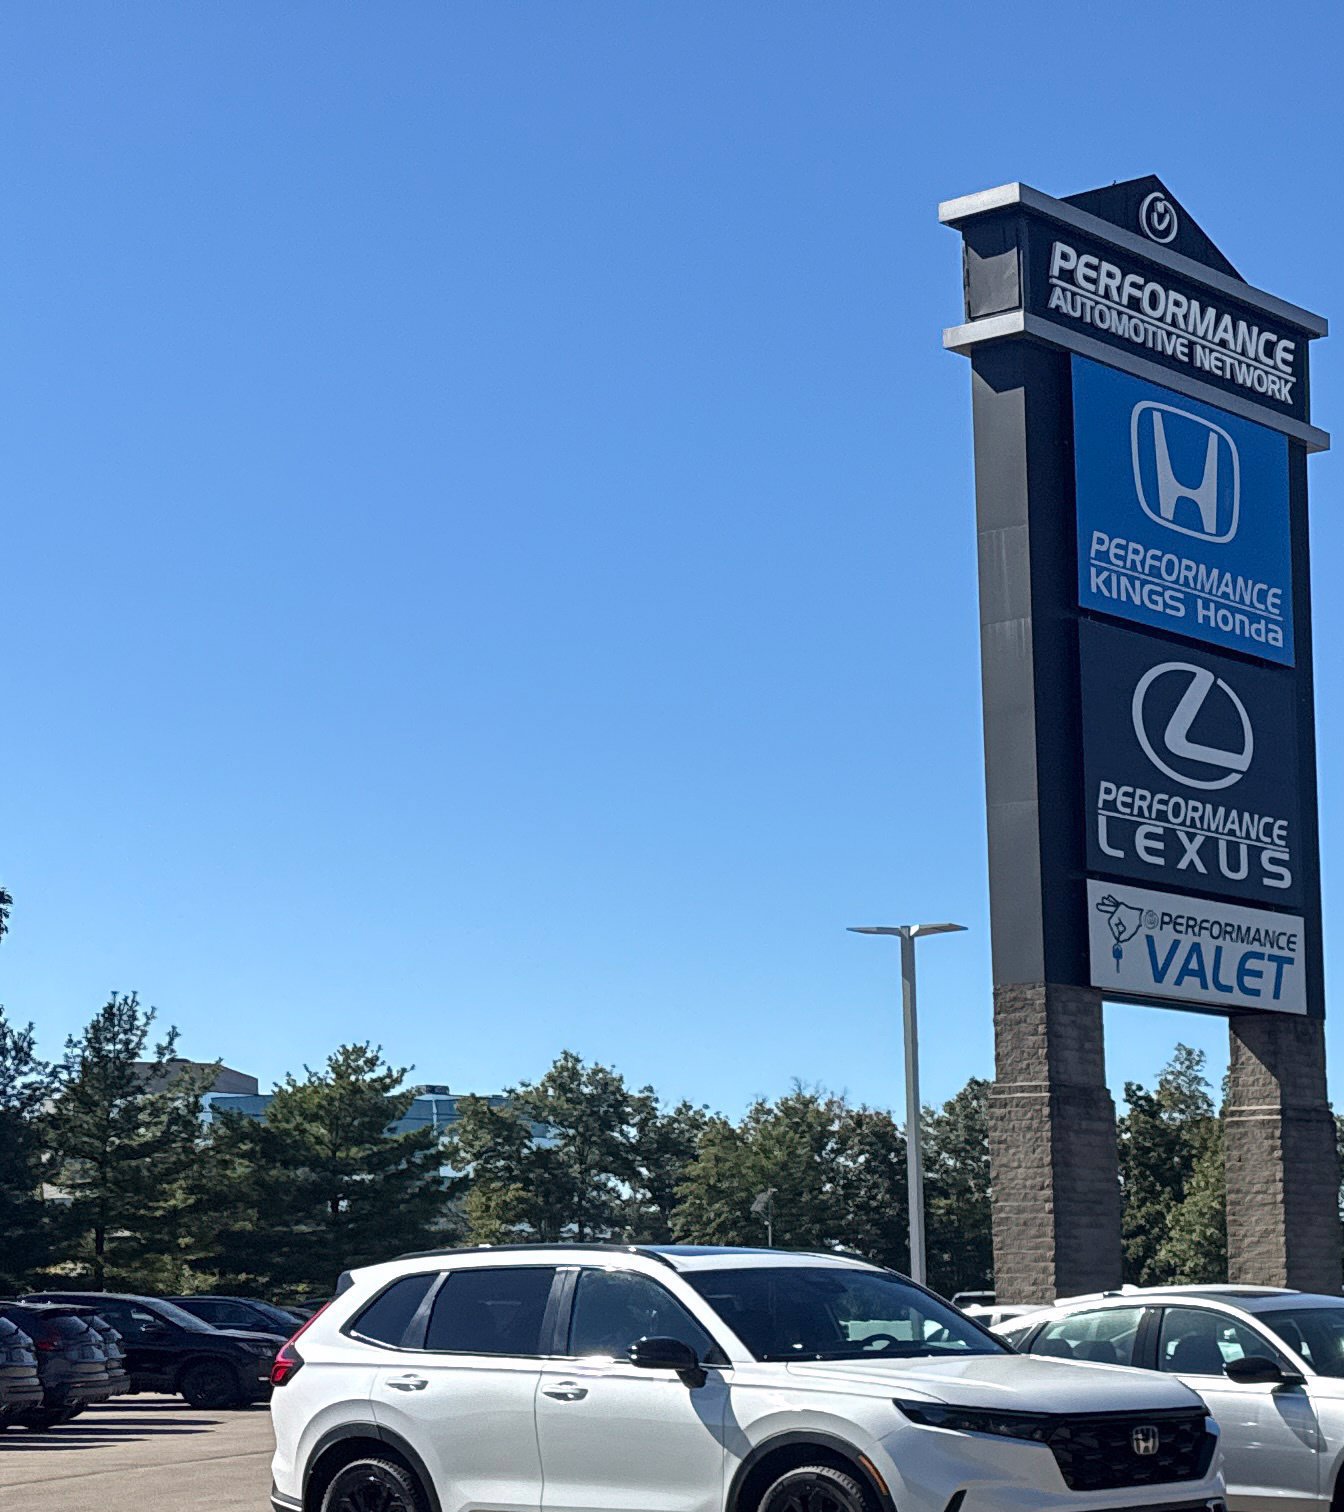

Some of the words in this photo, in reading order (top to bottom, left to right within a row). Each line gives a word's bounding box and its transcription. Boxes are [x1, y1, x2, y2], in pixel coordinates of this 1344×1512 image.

[1050, 241, 1295, 372] PERFORMANCE
[1048, 287, 1189, 363] AUTOMOTIVE
[1193, 344, 1293, 404] NETWORK
[1090, 569, 1186, 616] KINGS
[1197, 597, 1284, 649] Honda
[1091, 530, 1283, 616] PERFORMANCE
[1098, 781, 1288, 846] PERFORMANCE
[1099, 814, 1293, 889] LEXUS
[1145, 934, 1295, 1001] VALET
[1159, 912, 1298, 953] PERFORMANCE
